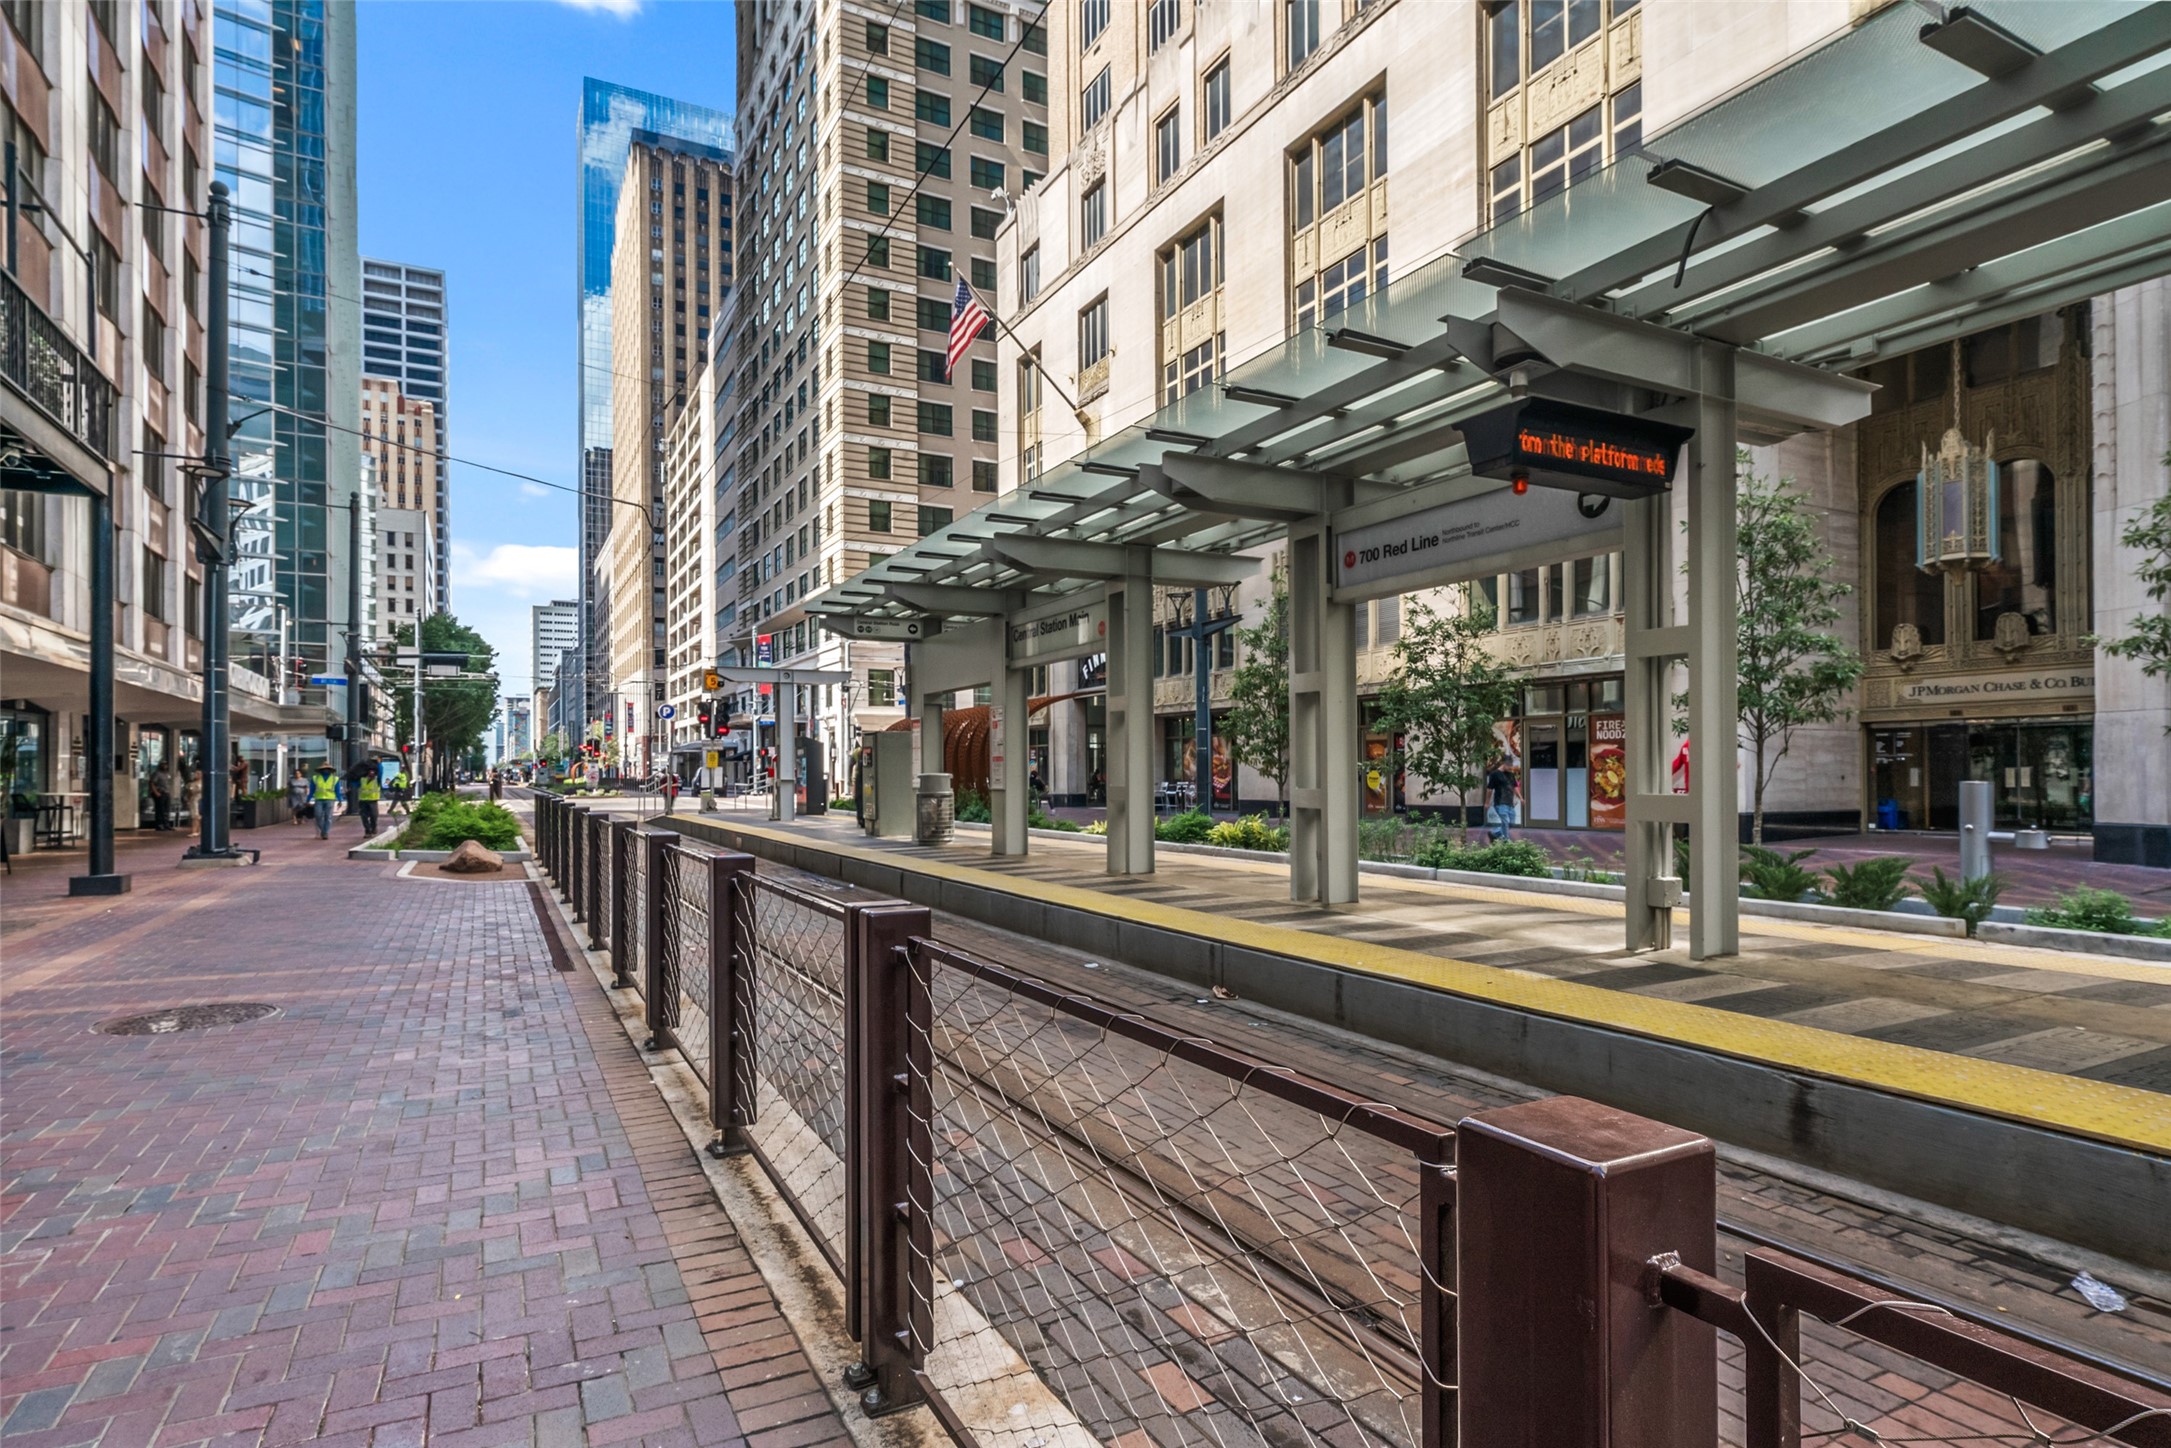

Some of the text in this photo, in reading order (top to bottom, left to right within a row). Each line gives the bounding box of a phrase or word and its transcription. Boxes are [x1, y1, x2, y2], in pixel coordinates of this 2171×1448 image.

[1550, 433, 1574, 459] the
[1580, 439, 1639, 471] platform
[1441, 521, 1480, 536] Northbound to
[1467, 528, 1484, 539] Transit
[1359, 534, 1440, 564] 700 Red Line
[1013, 623, 1039, 643] Central
[1040, 617, 1067, 636] Station
[2029, 679, 2043, 690] &
[662, 706, 672, 717] P
